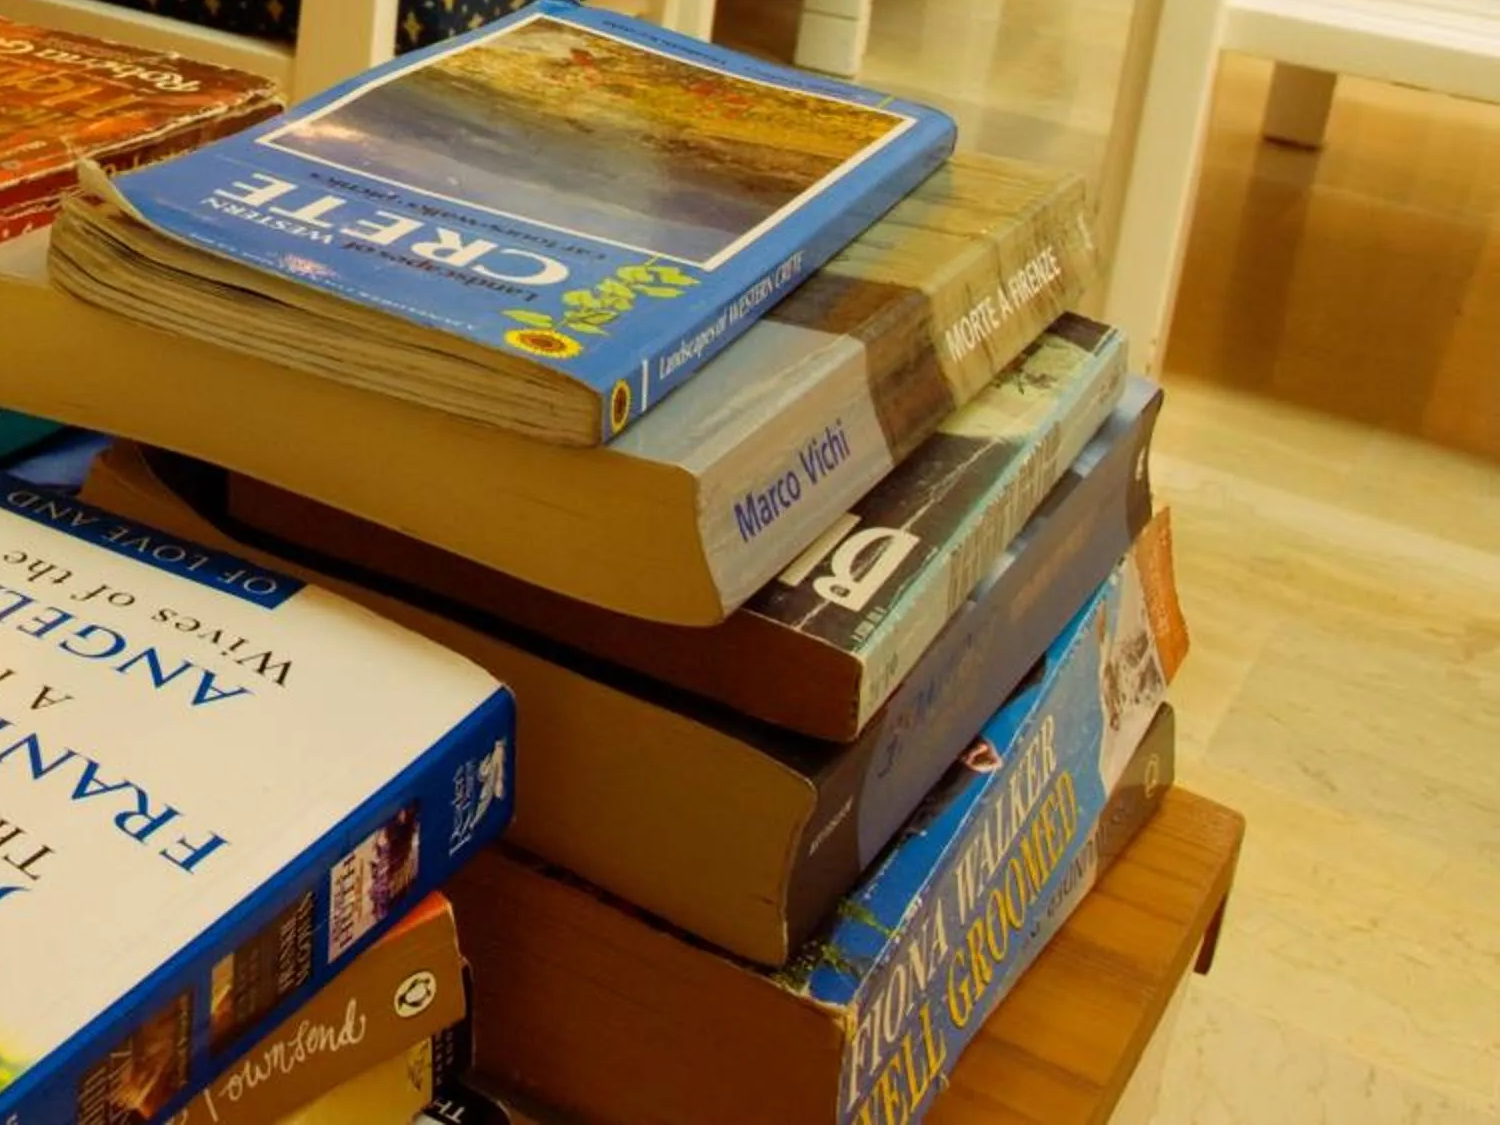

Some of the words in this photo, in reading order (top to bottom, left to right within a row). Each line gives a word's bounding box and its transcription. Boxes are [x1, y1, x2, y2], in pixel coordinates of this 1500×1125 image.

[203, 197, 336, 246] WESTERN
[212, 172, 572, 288] CRETE
[658, 327, 717, 380] Landscapes
[728, 272, 776, 324] WESTERN
[945, 295, 1001, 364] MORTE
[1008, 245, 1062, 311] FIRENZE
[7, 487, 102, 529] AND
[733, 471, 801, 544] Marco
[799, 418, 852, 487] Vichi
[3, 550, 73, 585] the
[106, 523, 212, 568] LOVE
[69, 583, 136, 607] of
[218, 561, 280, 598] OF
[151, 604, 296, 690] Wives
[30, 684, 76, 713] A
[844, 899, 950, 1113] FIONA
[954, 713, 1059, 925] WALKER
[945, 769, 1080, 1030] GROOMED
